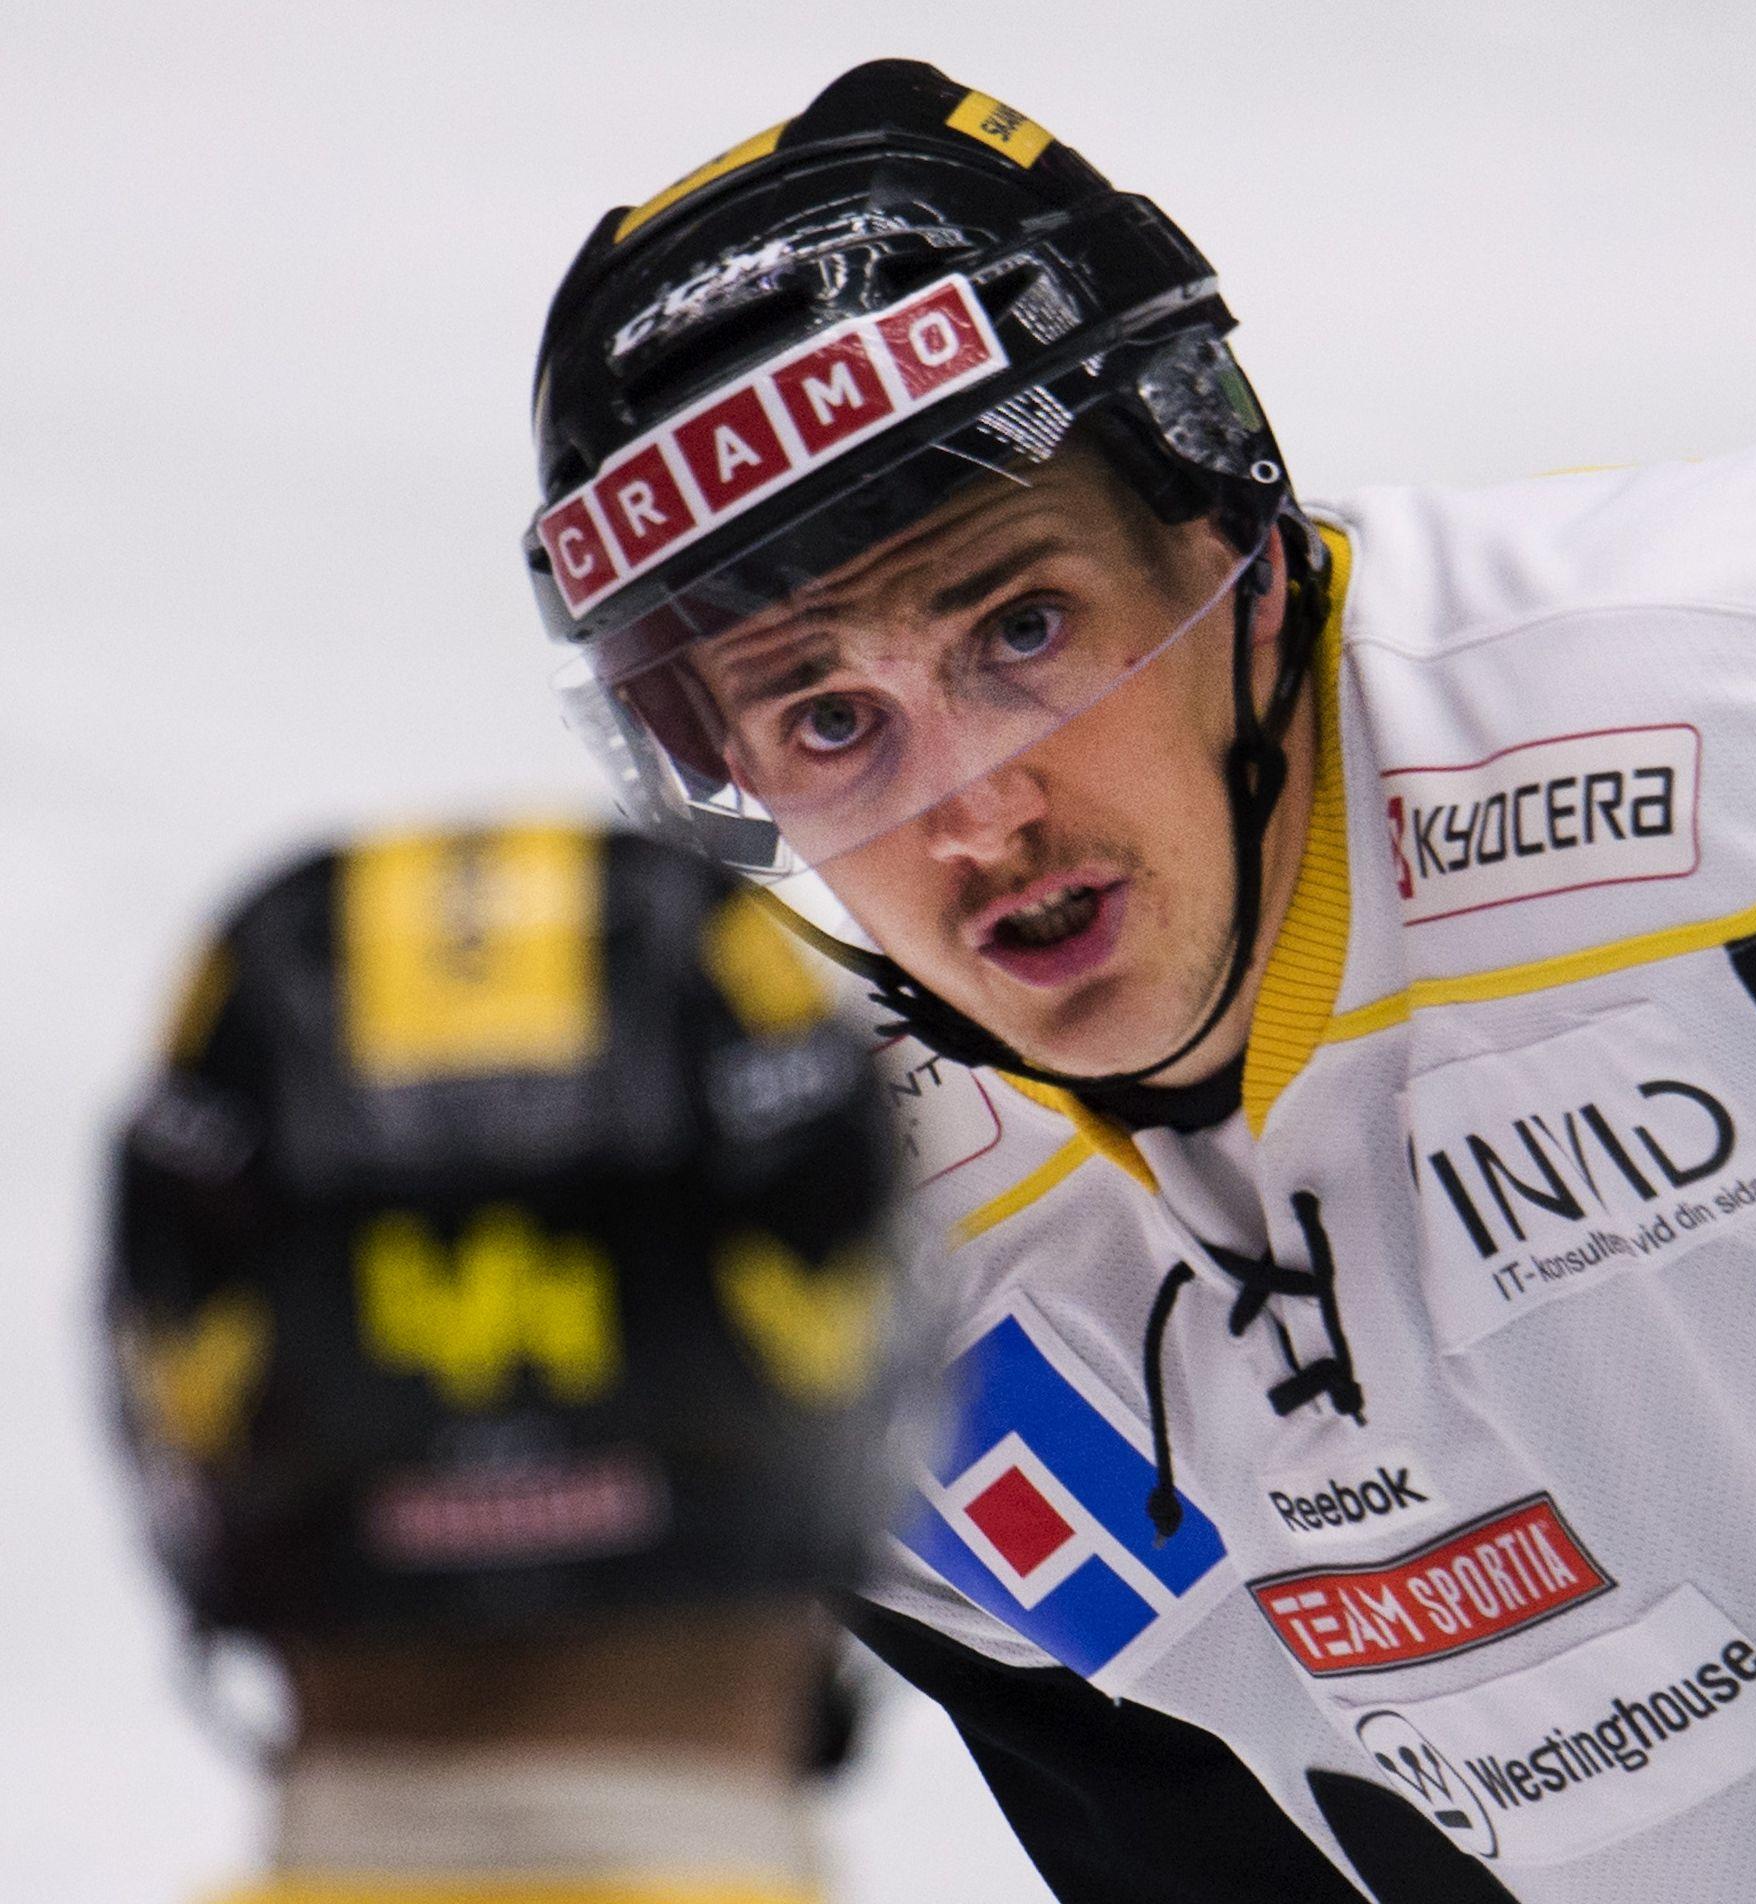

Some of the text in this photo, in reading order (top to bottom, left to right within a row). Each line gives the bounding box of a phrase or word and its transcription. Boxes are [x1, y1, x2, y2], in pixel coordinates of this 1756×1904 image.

[555, 311, 962, 580] CRAMO
[1427, 1078, 1738, 1260] INVID
[1630, 1212, 1678, 1256] vid
[1674, 1201, 1717, 1231] din
[1267, 1465, 1431, 1533] Reebok
[1269, 1521, 1580, 1660] TEAM SPORTIA
